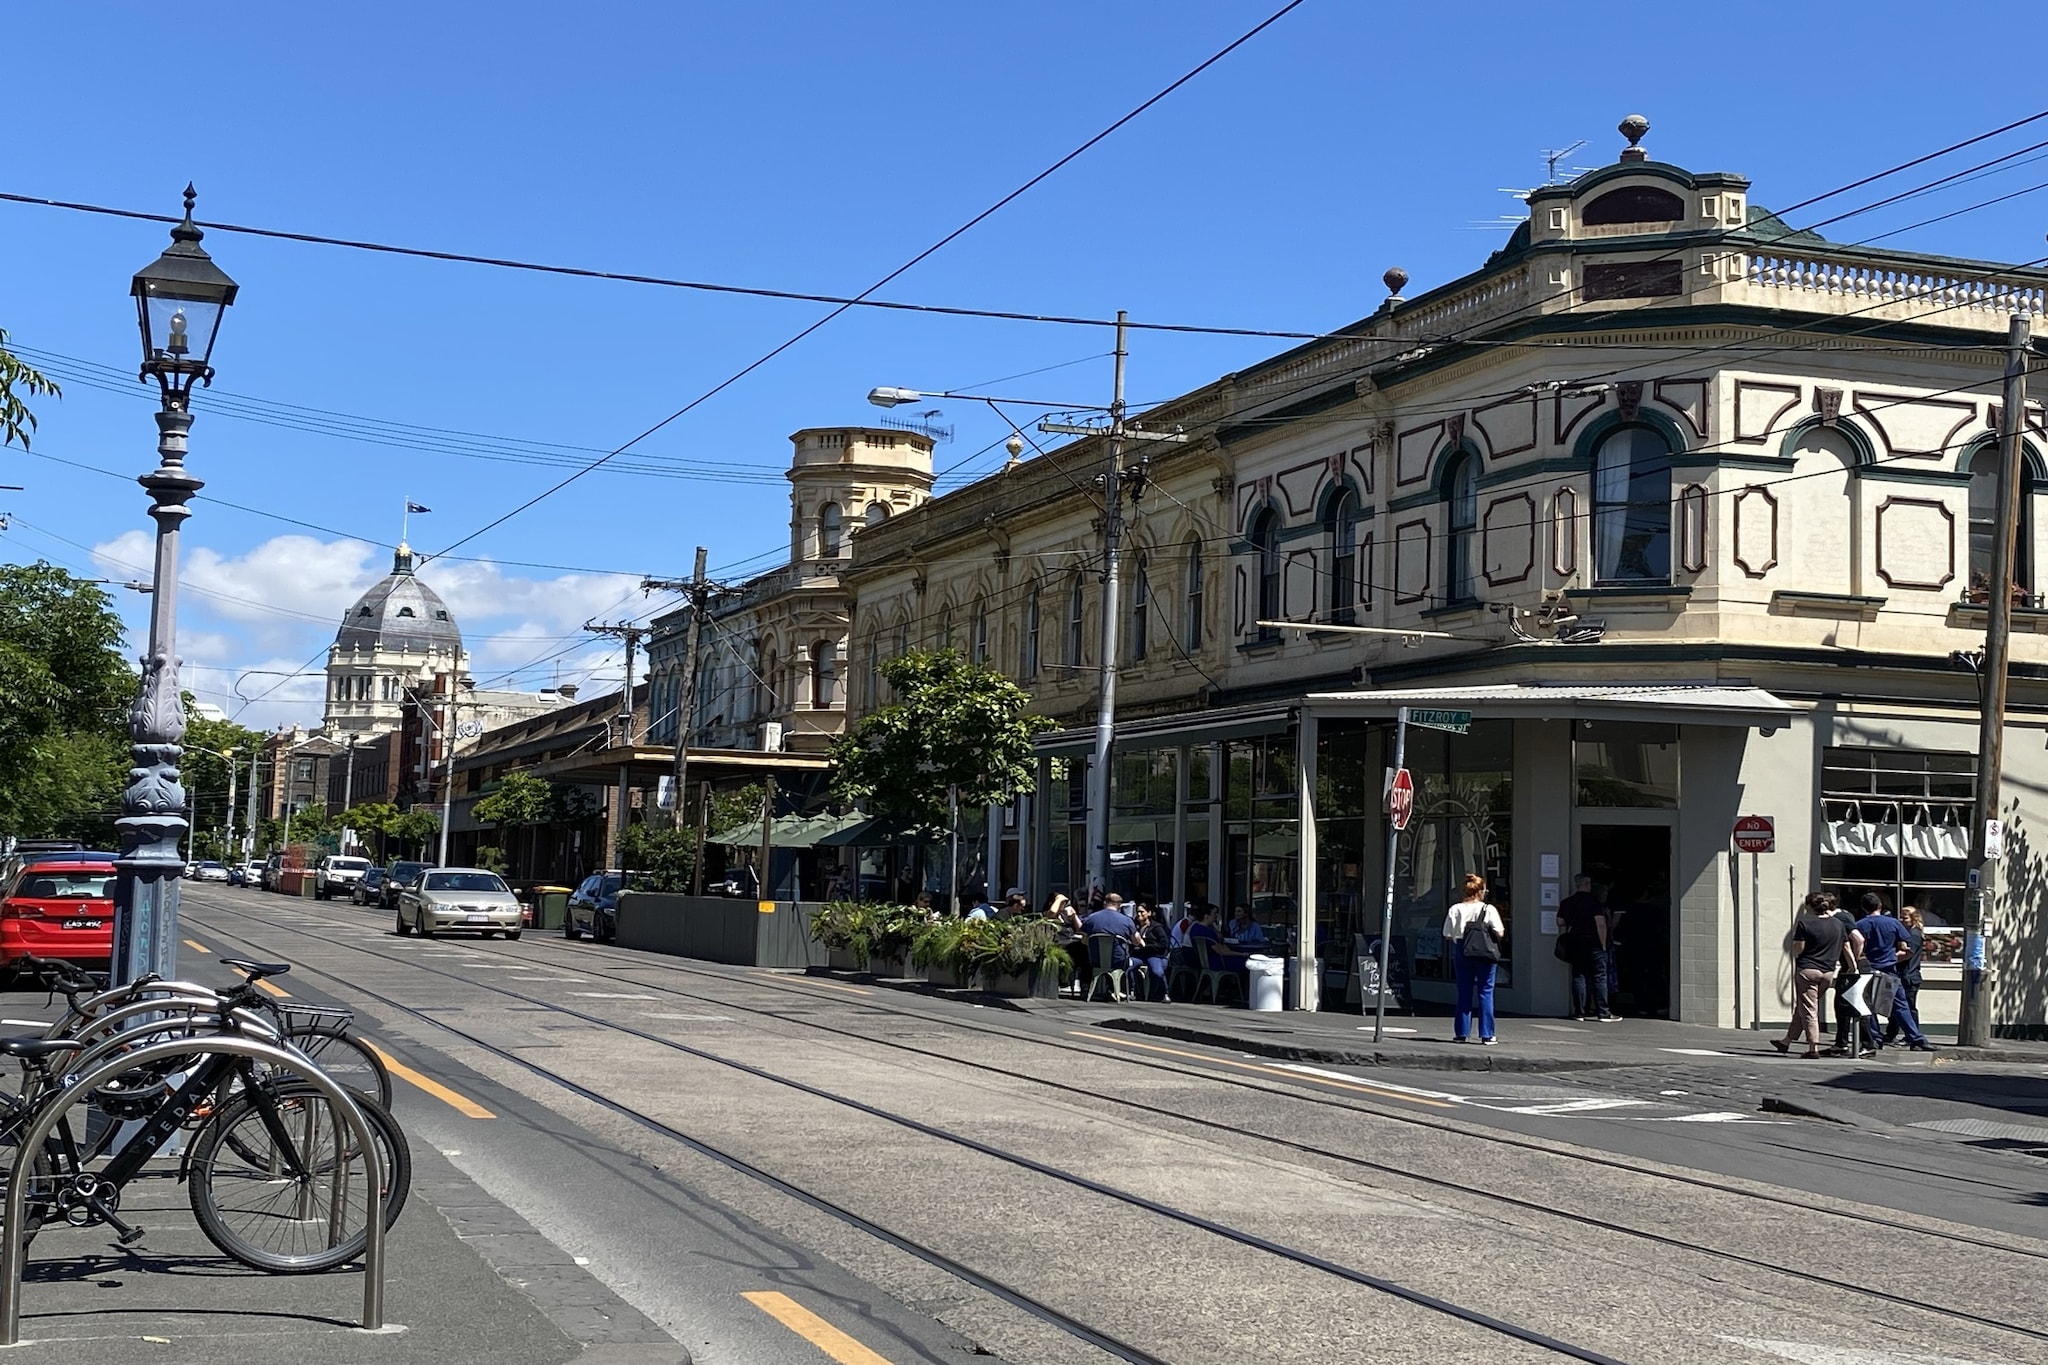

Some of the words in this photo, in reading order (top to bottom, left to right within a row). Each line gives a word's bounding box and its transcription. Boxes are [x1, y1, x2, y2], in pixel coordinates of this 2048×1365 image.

[1412, 710, 1457, 723] FITZROY
[1391, 787, 1411, 809] STOP
[1747, 821, 1760, 830] NO
[1739, 839, 1768, 848] ENTRY
